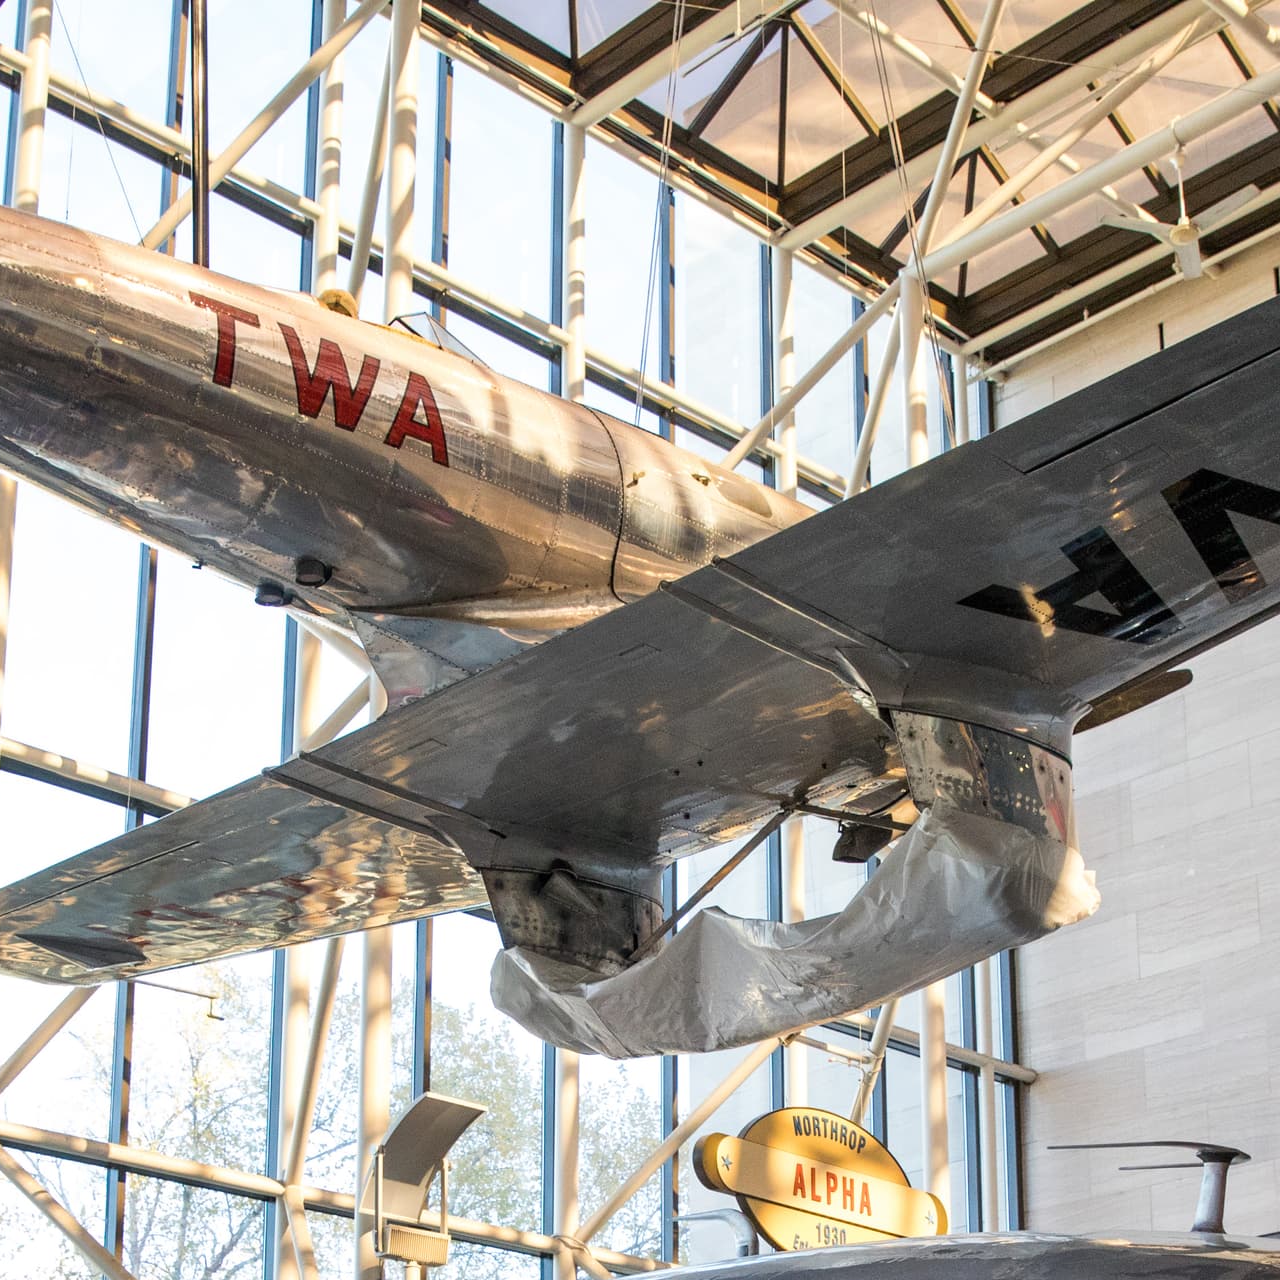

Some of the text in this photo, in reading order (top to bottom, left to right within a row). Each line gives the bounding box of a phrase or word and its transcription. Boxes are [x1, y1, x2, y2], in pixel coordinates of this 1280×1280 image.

[189, 290, 450, 468] TWA
[792, 1114, 867, 1155] NORTHROP
[792, 1163, 872, 1217] ALPHA
[815, 1222, 846, 1247] 1930
